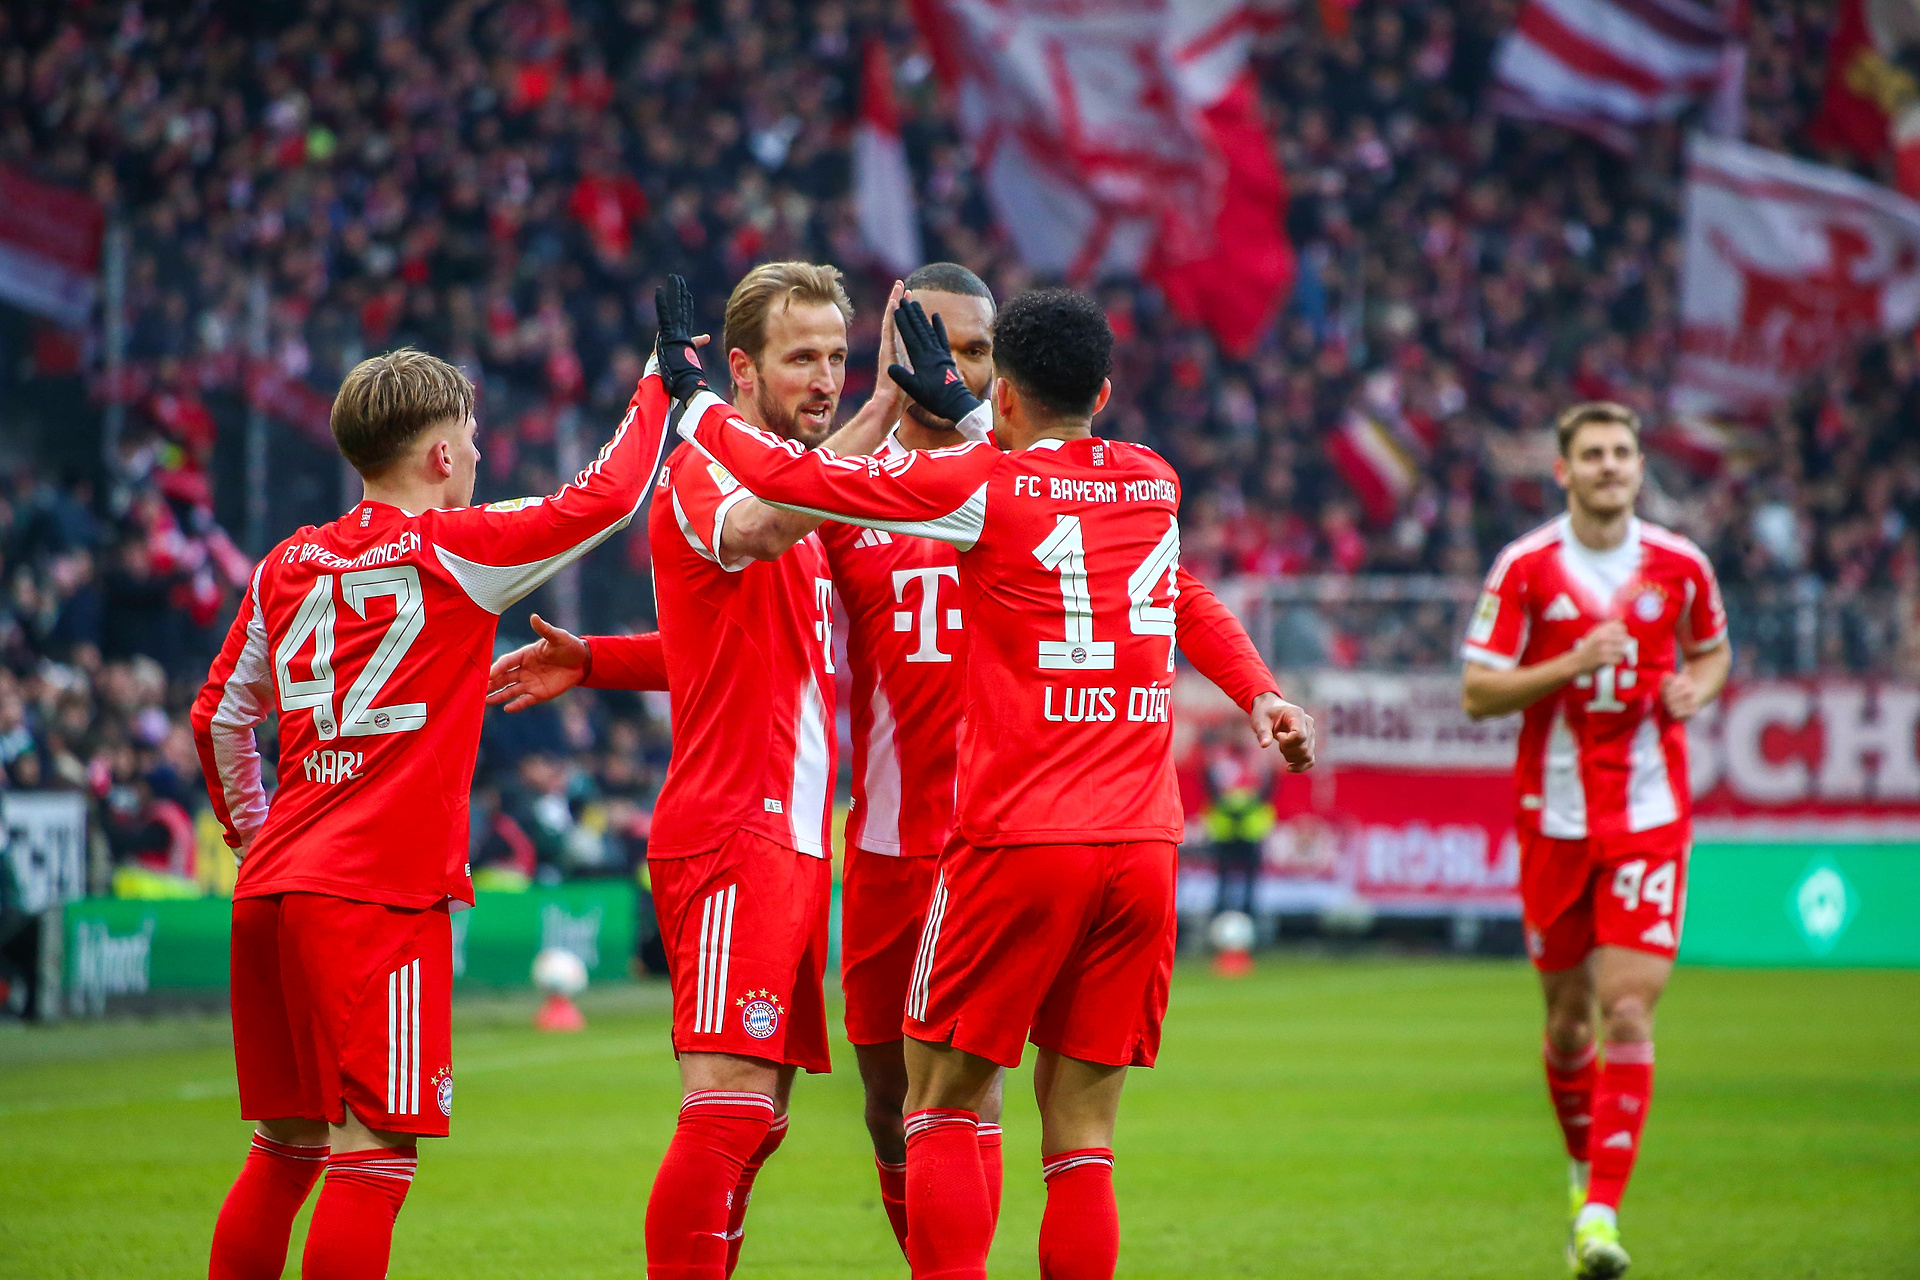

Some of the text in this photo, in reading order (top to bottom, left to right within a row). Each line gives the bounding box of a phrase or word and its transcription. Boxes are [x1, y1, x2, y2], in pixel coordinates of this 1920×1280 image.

[1014, 475, 1041, 497] FC
[1050, 477, 1117, 503] BAYERN
[281, 545, 301, 564] FC
[299, 543, 358, 568] BAYERN
[1031, 514, 1181, 673] 14
[275, 565, 428, 741] 42
[1044, 686, 1117, 722] LUIS
[303, 750, 364, 785] KARL
